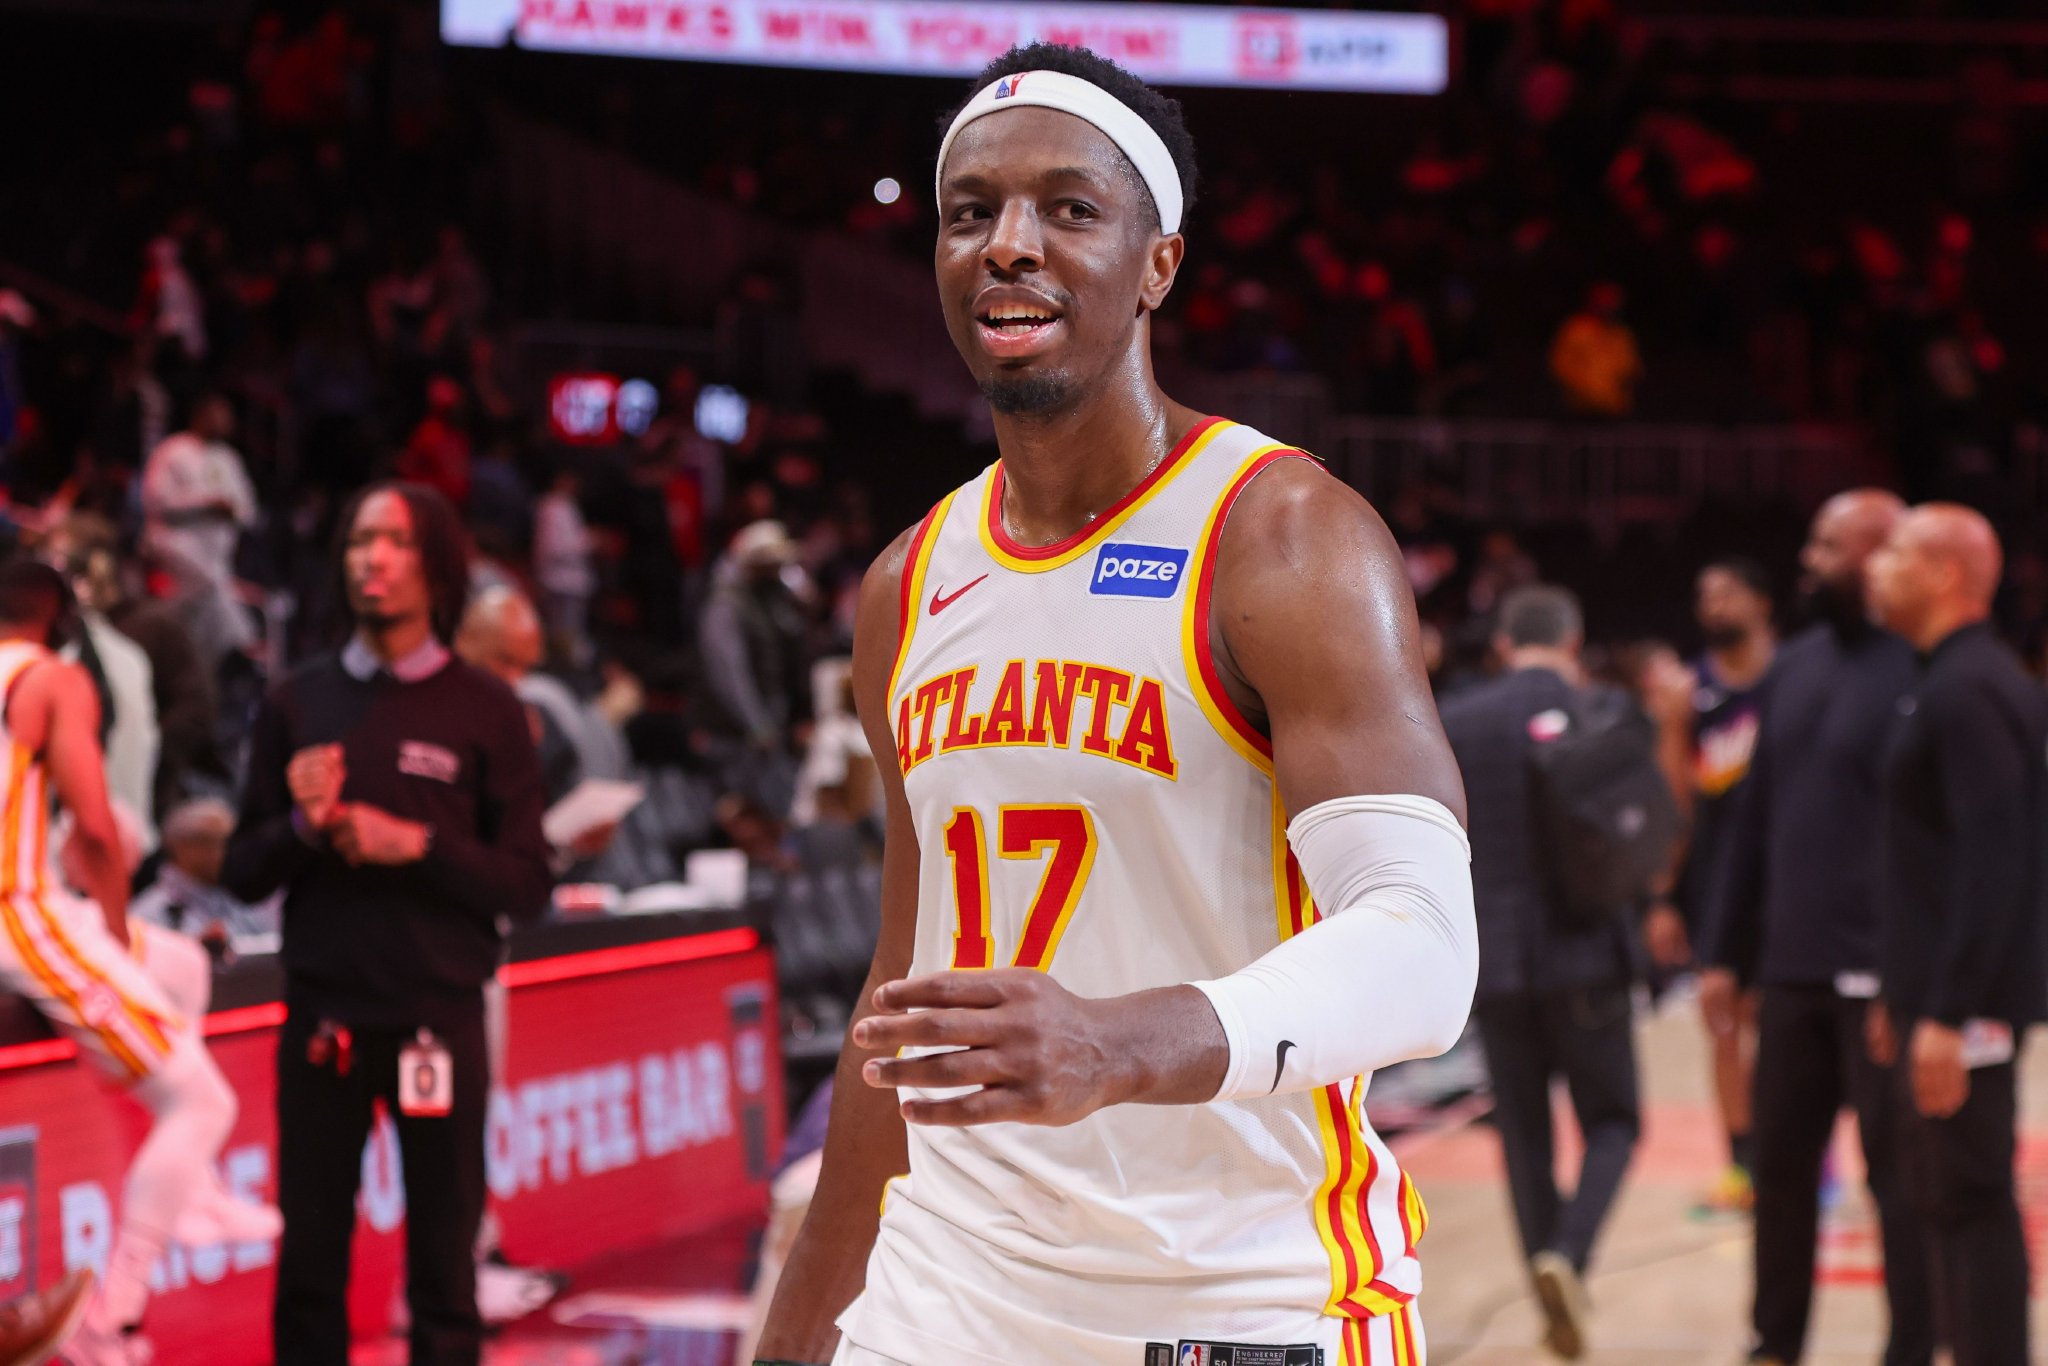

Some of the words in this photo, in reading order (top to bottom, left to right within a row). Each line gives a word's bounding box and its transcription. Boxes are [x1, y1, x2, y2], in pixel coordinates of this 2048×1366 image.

[1097, 557, 1178, 584] paze
[897, 658, 1178, 782] ATLANTA
[942, 802, 1098, 975] 17
[638, 1040, 732, 1160] BAR
[1236, 1350, 1284, 1358] ENGINEERED
